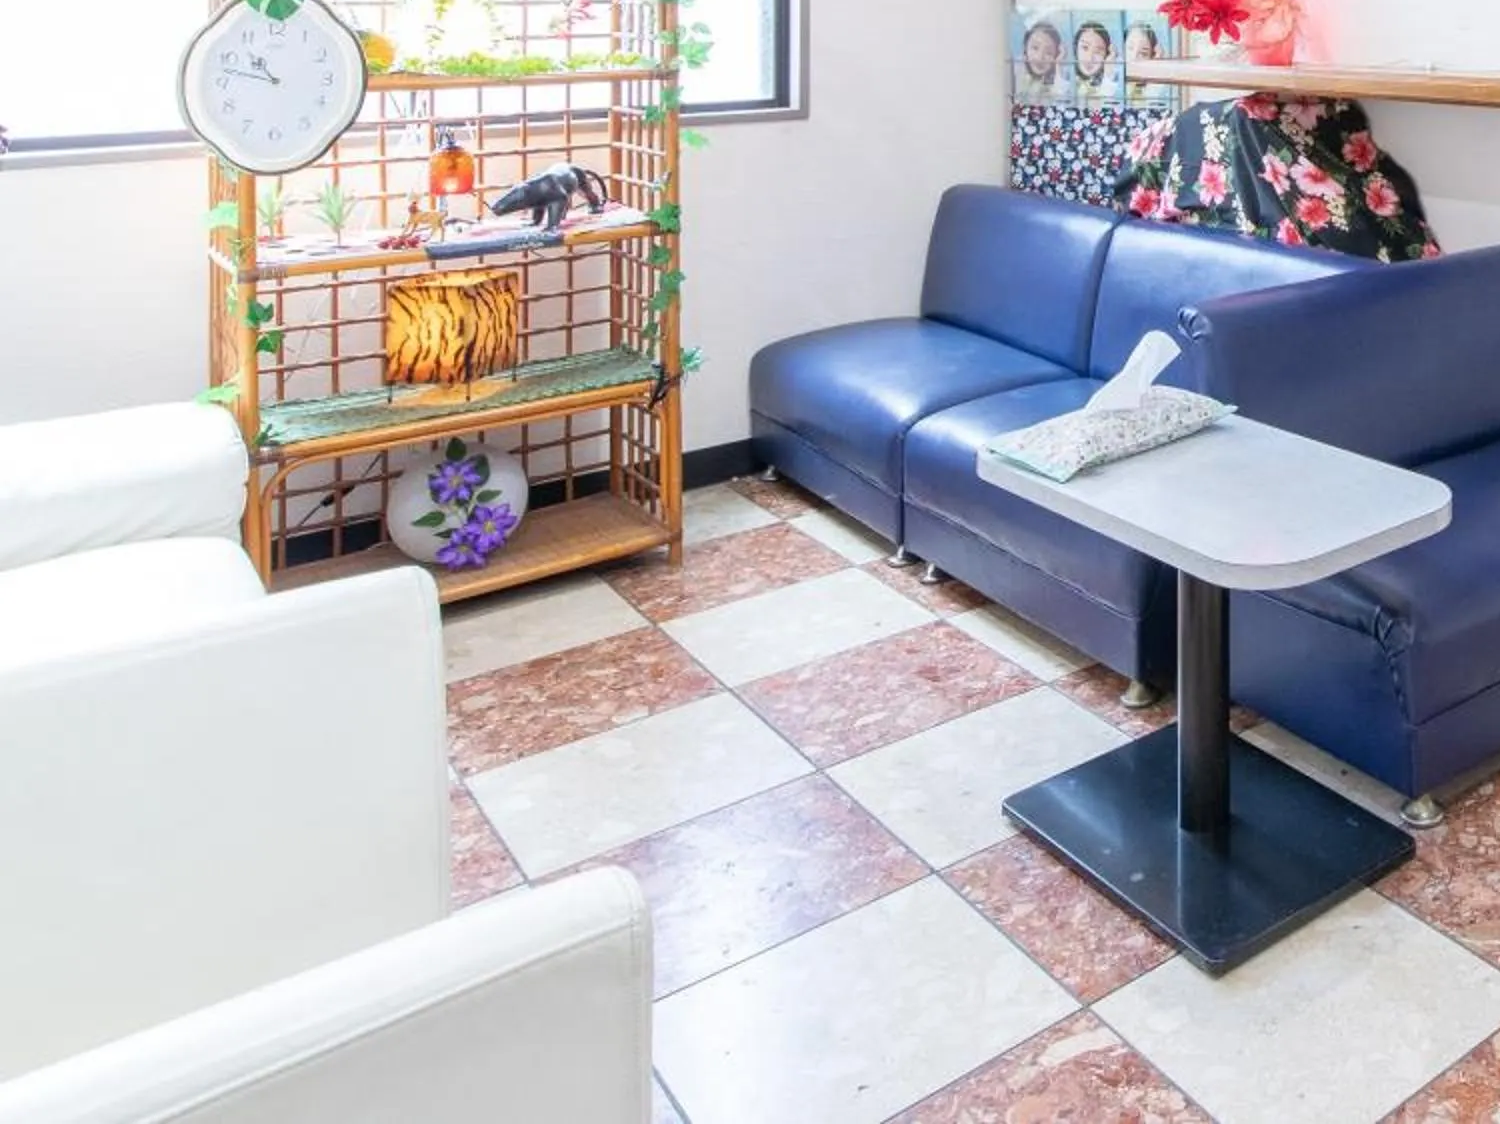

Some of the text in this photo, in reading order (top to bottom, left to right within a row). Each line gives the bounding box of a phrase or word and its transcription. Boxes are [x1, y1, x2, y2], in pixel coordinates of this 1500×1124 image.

[243, 30, 254, 45] 11
[268, 23, 287, 37] 12
[220, 50, 239, 66] 10
[215, 77, 230, 90] 9
[320, 71, 334, 87] 3
